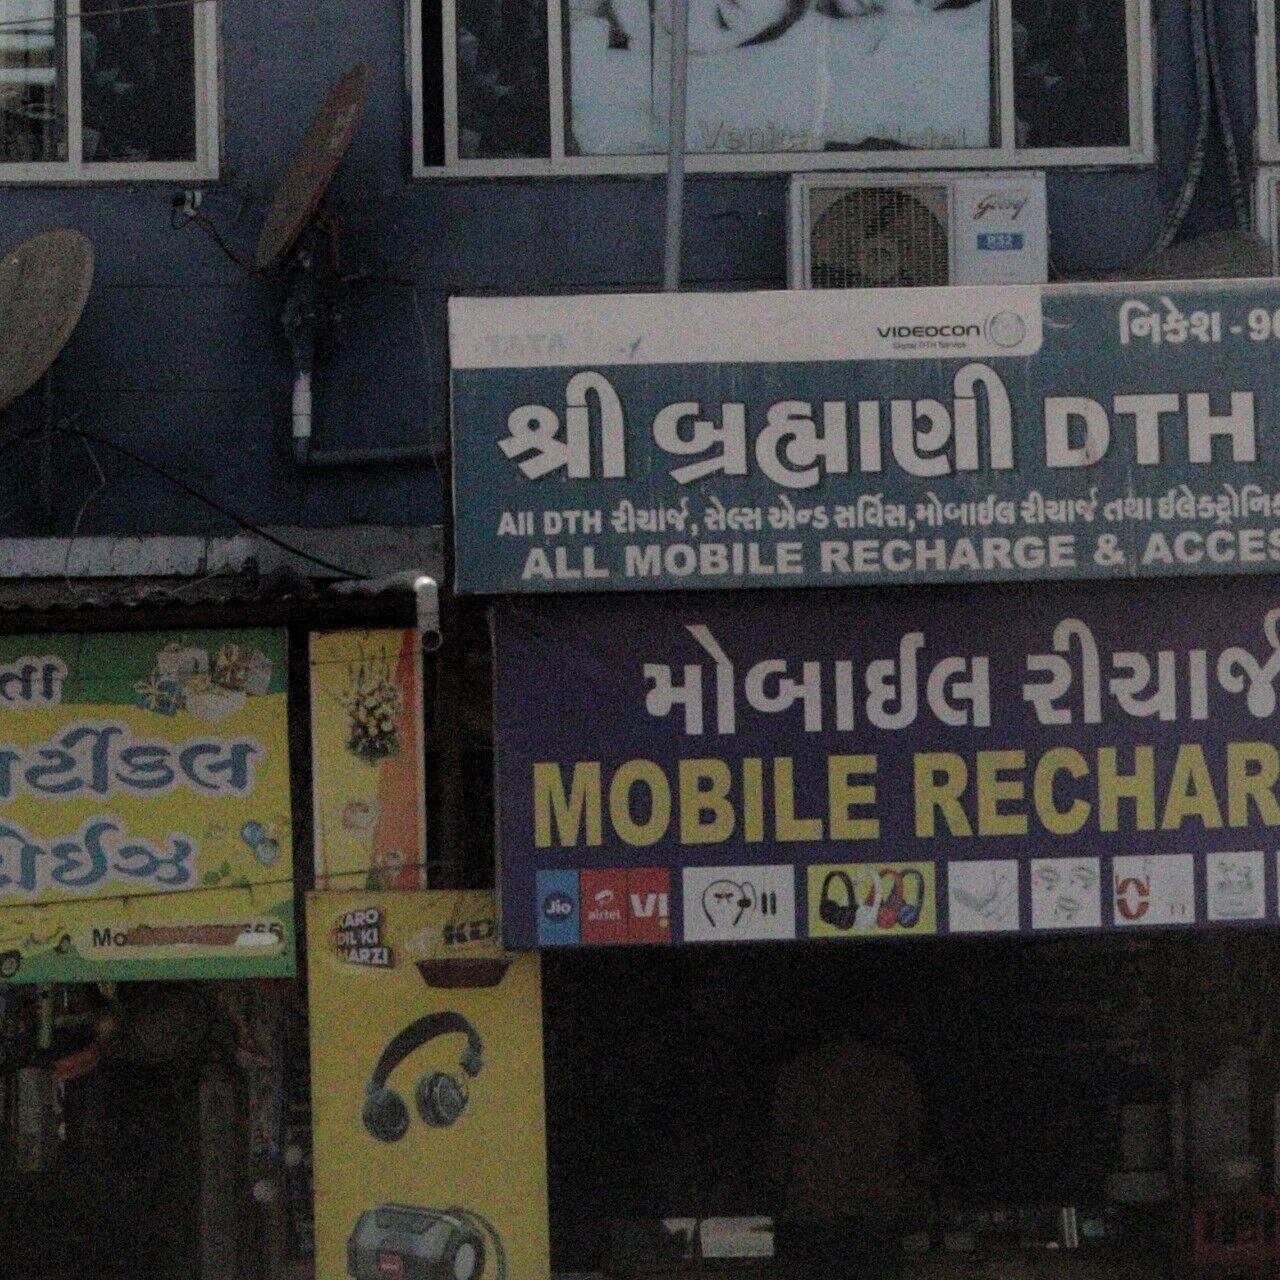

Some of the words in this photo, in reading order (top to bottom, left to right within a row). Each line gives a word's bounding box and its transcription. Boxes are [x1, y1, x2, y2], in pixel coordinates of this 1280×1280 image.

[877, 324, 981, 339] VIDEOCON
[1119, 296, 1221, 346] નિકેશ
[497, 371, 627, 480] શ્રી
[652, 363, 1015, 490] બ્રહ્માણી
[1044, 391, 1256, 468] DTH
[497, 512, 535, 537] All
[543, 510, 602, 536] DTH
[611, 496, 699, 538] રીચાર્જ,
[767, 494, 830, 532] એન્ડ
[1020, 487, 1099, 525] રીચાર્જ
[1103, 493, 1153, 522] તથા
[520, 545, 611, 581] ALL
[624, 541, 804, 578] MOBILE
[820, 534, 1077, 576] RECHARGE
[1093, 533, 1125, 567] &
[642, 624, 993, 737] મોબાઈલ
[531, 753, 881, 850] MOBILE
[545, 898, 572, 916] Jio
[587, 909, 622, 922] airtel
